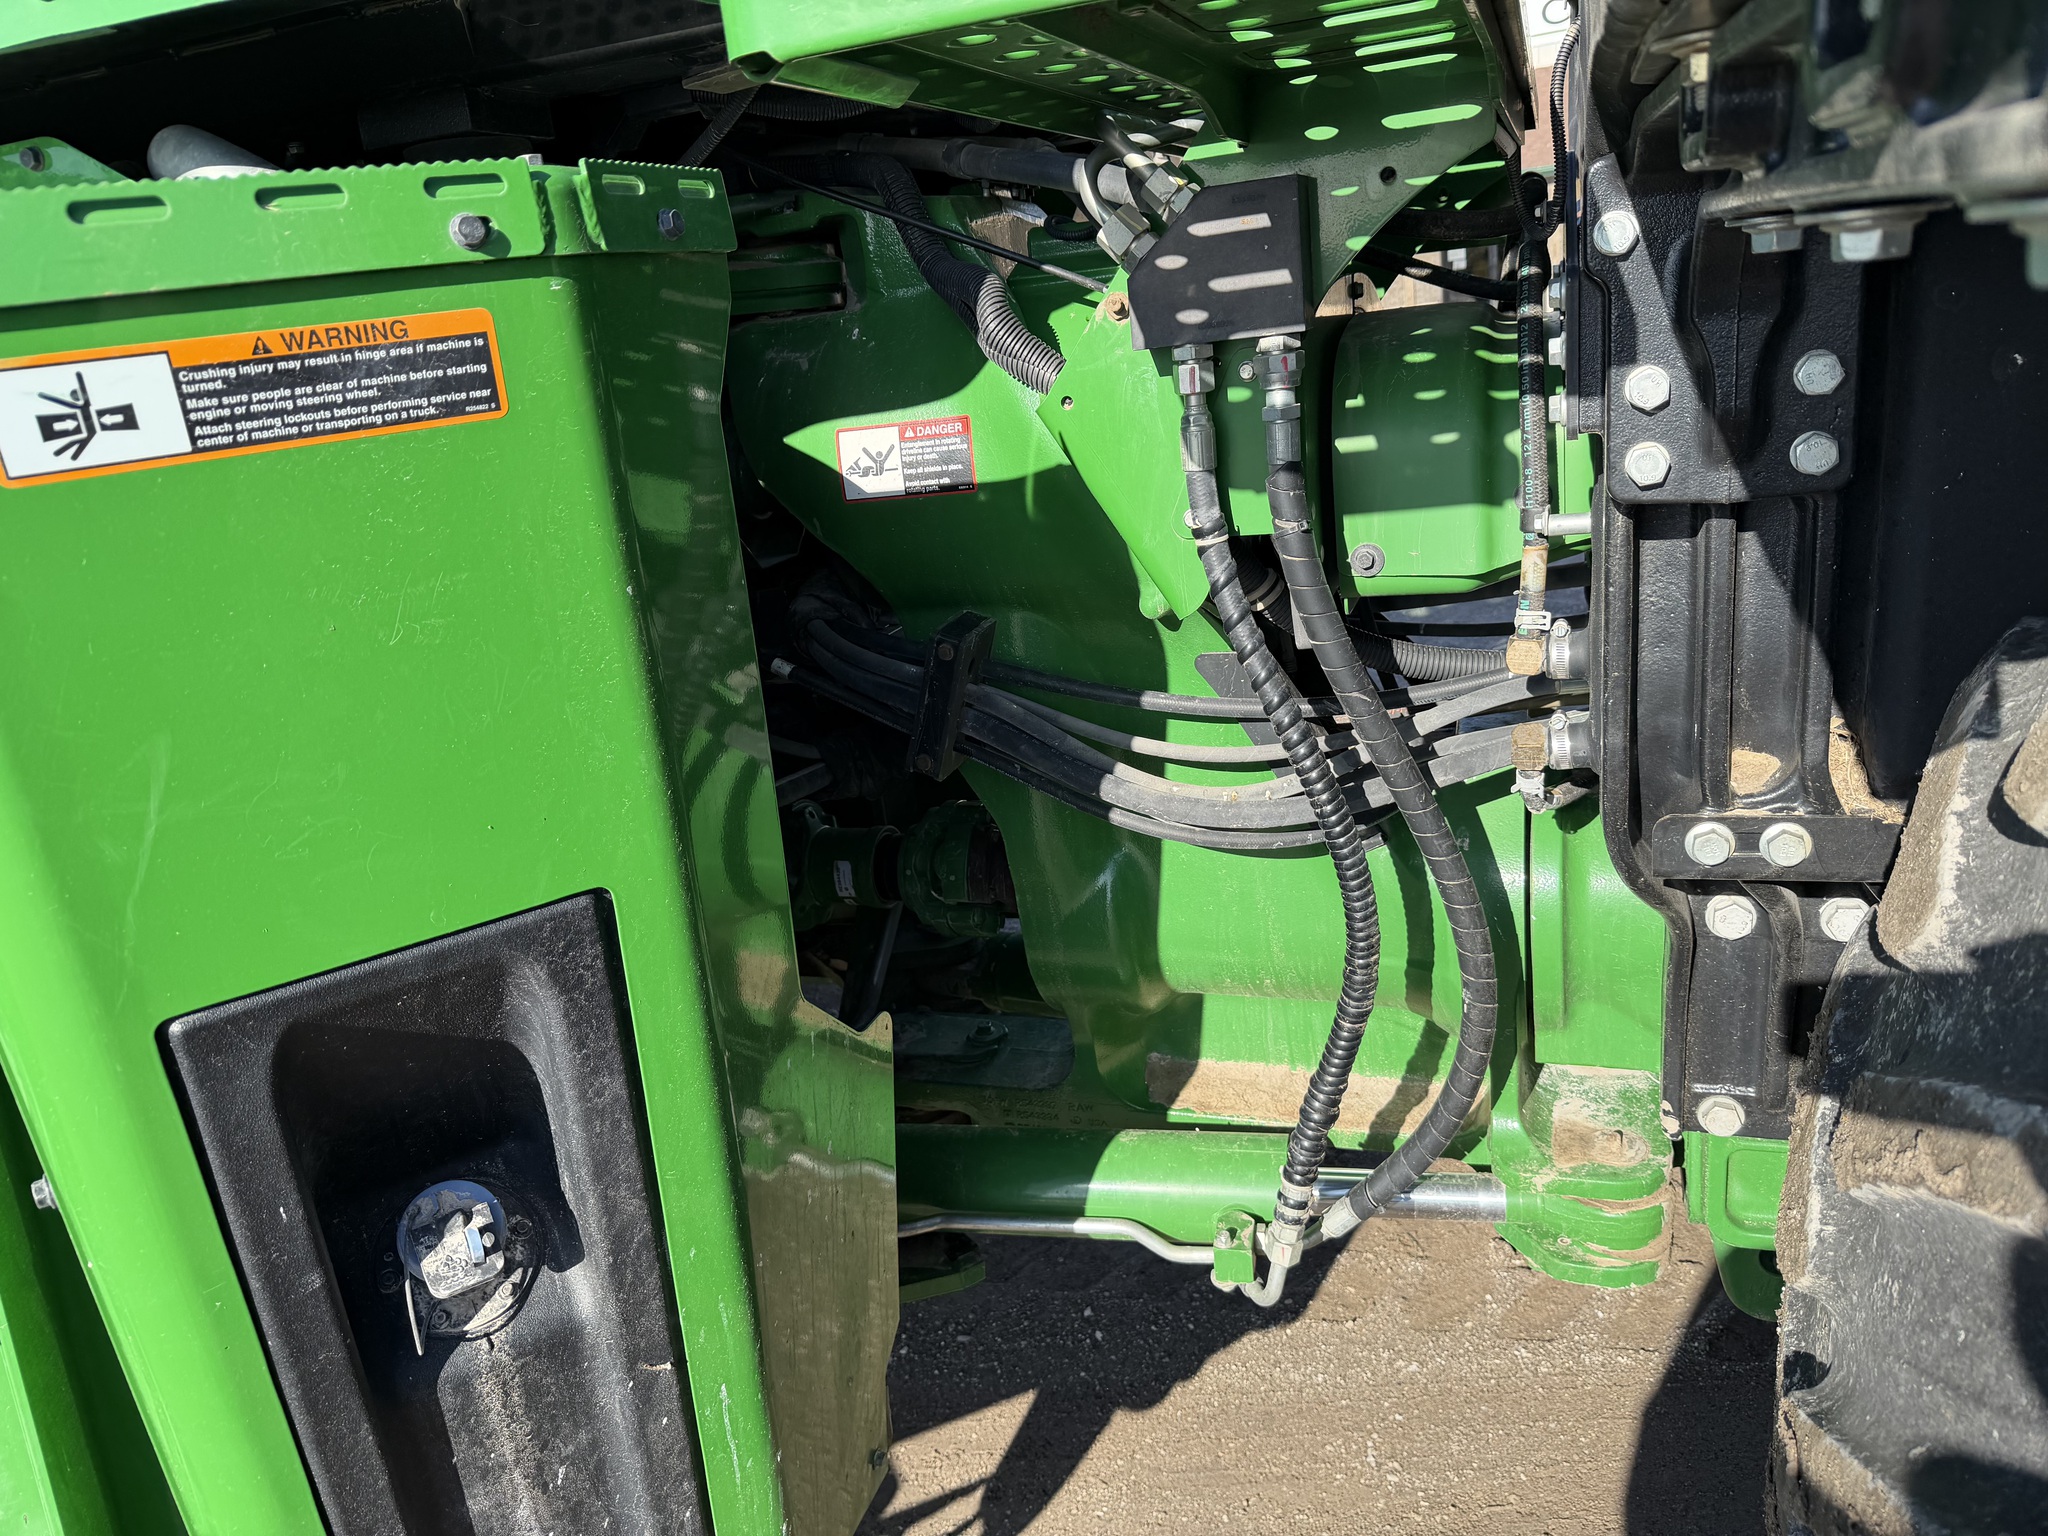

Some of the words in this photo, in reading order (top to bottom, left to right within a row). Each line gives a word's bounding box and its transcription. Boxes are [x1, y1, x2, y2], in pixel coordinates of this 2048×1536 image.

[1520, 281, 1530, 297] bar
[279, 320, 409, 351] WARNING
[1520, 323, 1529, 354] DN12
[178, 367, 237, 382] Crushing
[239, 363, 273, 375] injury
[277, 360, 301, 370] may
[304, 354, 338, 367] result
[340, 353, 352, 362] in
[354, 350, 387, 361] hinge
[389, 346, 413, 357] area
[416, 343, 423, 353] if
[426, 339, 471, 352] machine
[474, 337, 484, 346] is
[181, 379, 226, 393] turned.
[186, 397, 219, 409] Make
[221, 394, 249, 405] sure
[251, 387, 291, 402] people
[294, 386, 313, 395] are
[315, 382, 344, 393] clear
[346, 378, 358, 389] of
[361, 374, 407, 387] machine
[409, 369, 444, 380] before
[446, 363, 487, 376] starting
[189, 408, 231, 421] engine
[234, 406, 247, 415] or
[250, 398, 294, 413] moving
[296, 393, 343, 406] steering
[345, 387, 381, 400] wheel.
[194, 422, 233, 436] Attach
[235, 417, 282, 431] steering
[284, 410, 332, 424] lockouts
[333, 405, 368, 417] before
[370, 397, 428, 414] performing
[430, 392, 467, 404] service
[469, 389, 491, 398] near
[197, 435, 233, 448] center
[236, 431, 248, 442] of
[251, 424, 299, 439] machine
[301, 424, 313, 433] or
[315, 414, 383, 431] transporting
[384, 412, 398, 421] on
[401, 411, 407, 419] a
[409, 404, 439, 417] truck.
[916, 422, 962, 436] DANGER
[1523, 408, 1532, 430] mm
[949, 443, 968, 451] serious
[1523, 433, 1532, 458] 12.7
[902, 455, 916, 463] injury
[923, 452, 939, 460] death.
[948, 464, 964, 472] place.
[920, 478, 939, 486] contact
